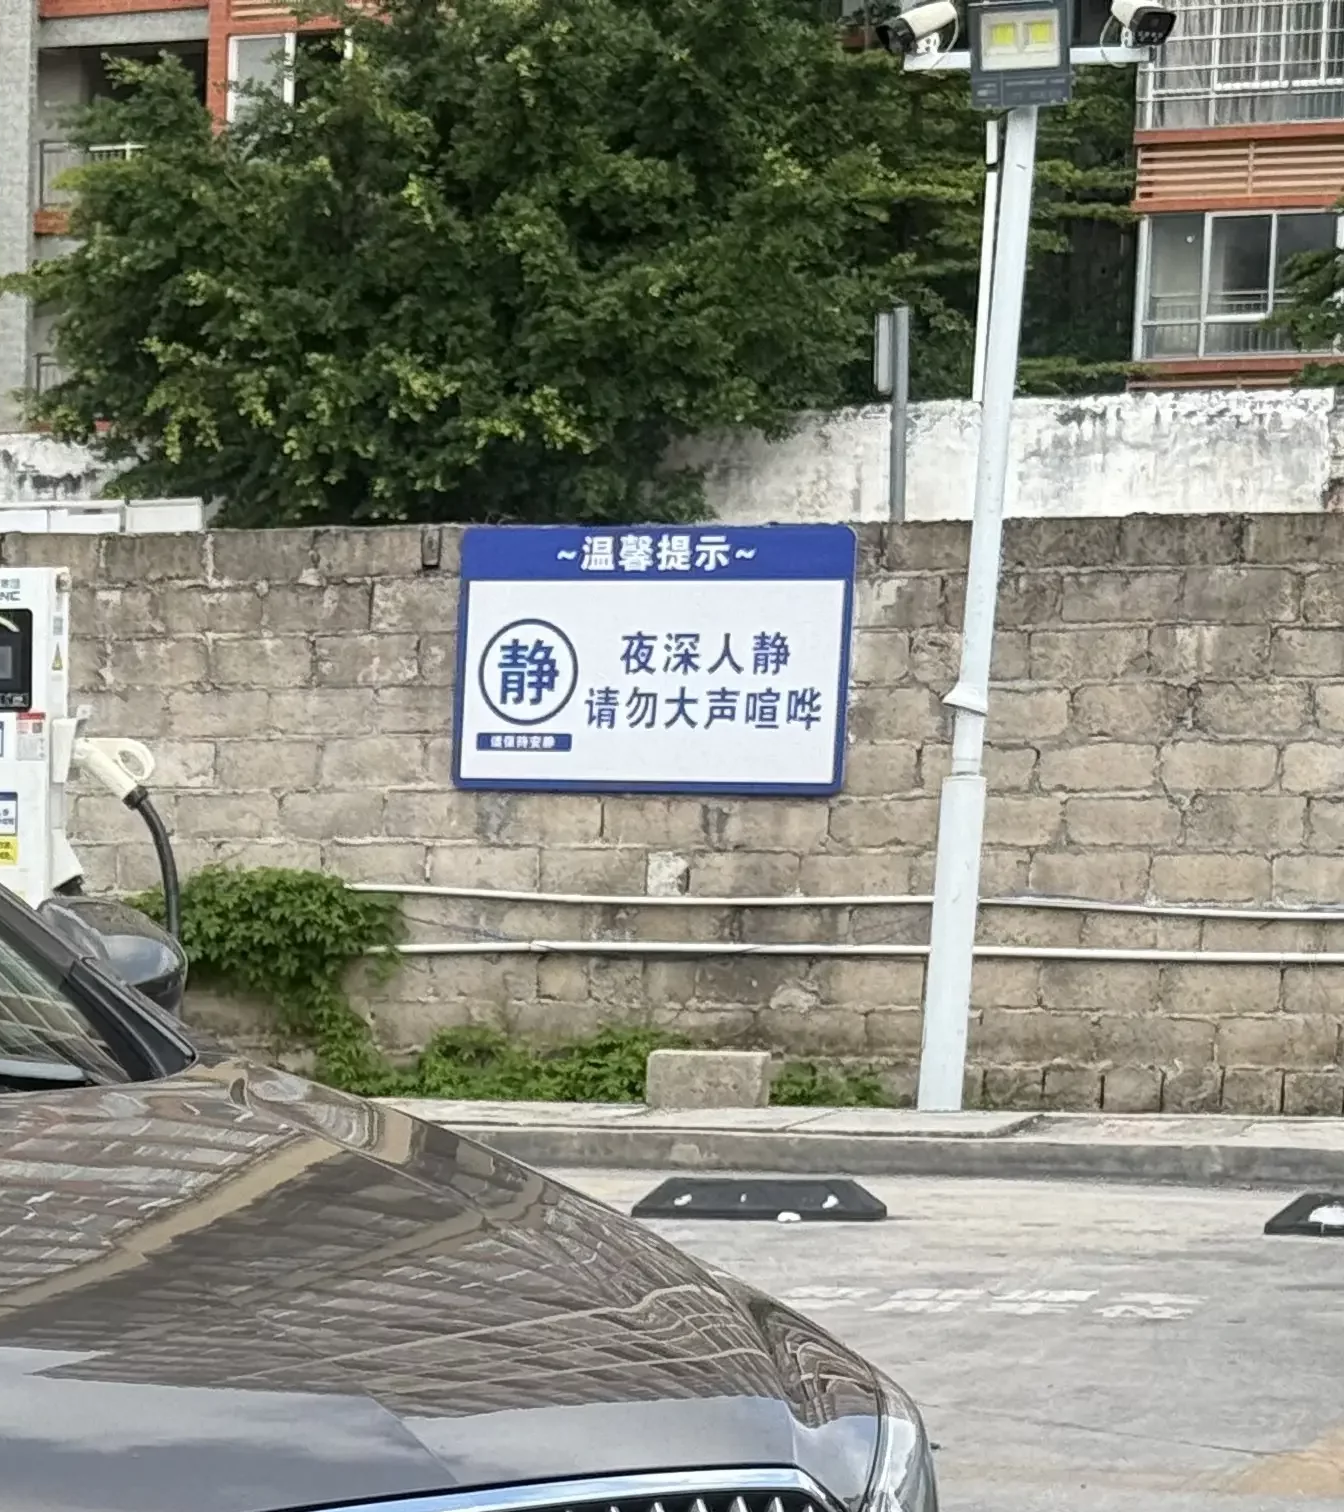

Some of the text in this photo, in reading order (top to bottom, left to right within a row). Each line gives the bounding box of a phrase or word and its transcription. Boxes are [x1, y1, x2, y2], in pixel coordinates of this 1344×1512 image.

[497, 638, 559, 706] 静
[620, 631, 792, 676] 夜深人静
[584, 686, 824, 730] 请勿大声喧哗
